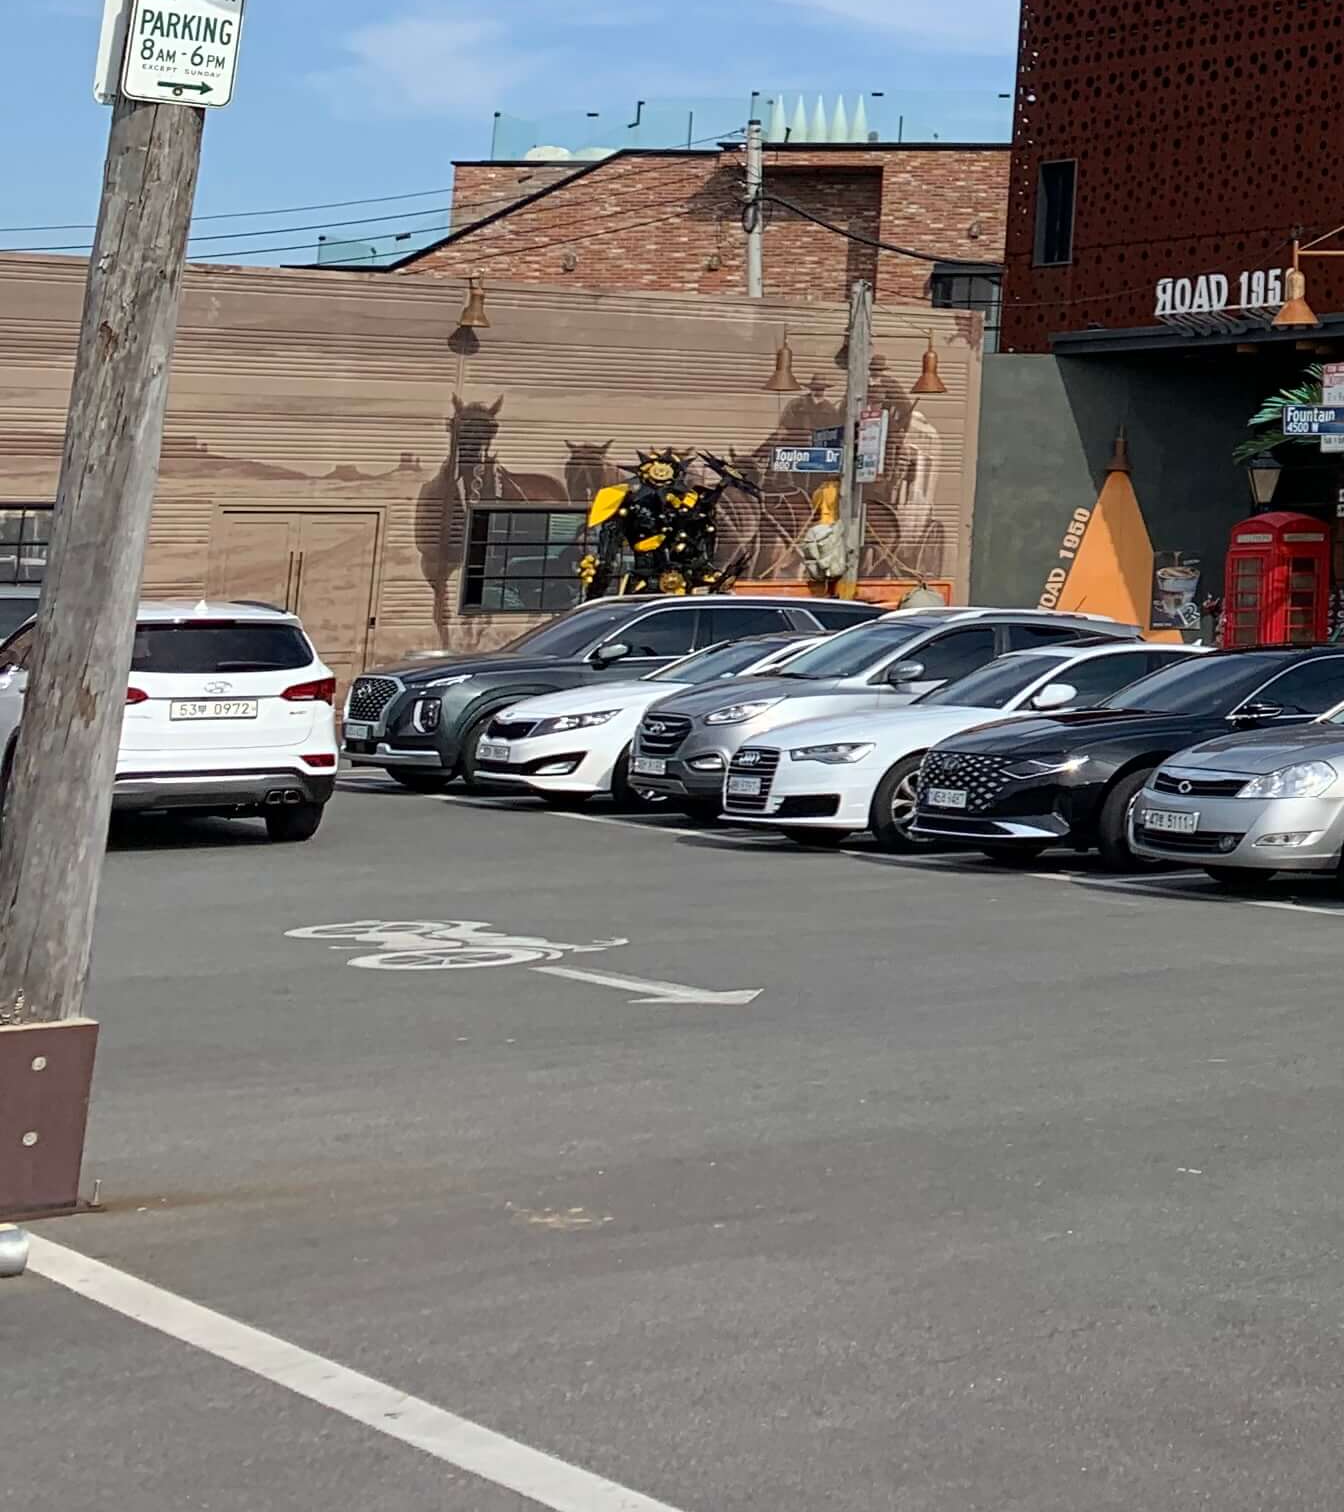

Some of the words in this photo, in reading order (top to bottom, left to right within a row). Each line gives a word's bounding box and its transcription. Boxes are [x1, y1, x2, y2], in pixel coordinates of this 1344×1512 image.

[140, 9, 233, 45] PARKING
[142, 64, 178, 73] EXCEPT
[185, 69, 221, 78] SUNDAY
[1287, 407, 1335, 422] Fountain
[1287, 423, 1309, 432] 4500
[1312, 423, 1319, 432] W
[775, 449, 810, 462] Toulon
[825, 450, 840, 462] Dr
[1060, 507, 1090, 559] 1950
[214, 702, 249, 715] 0972
